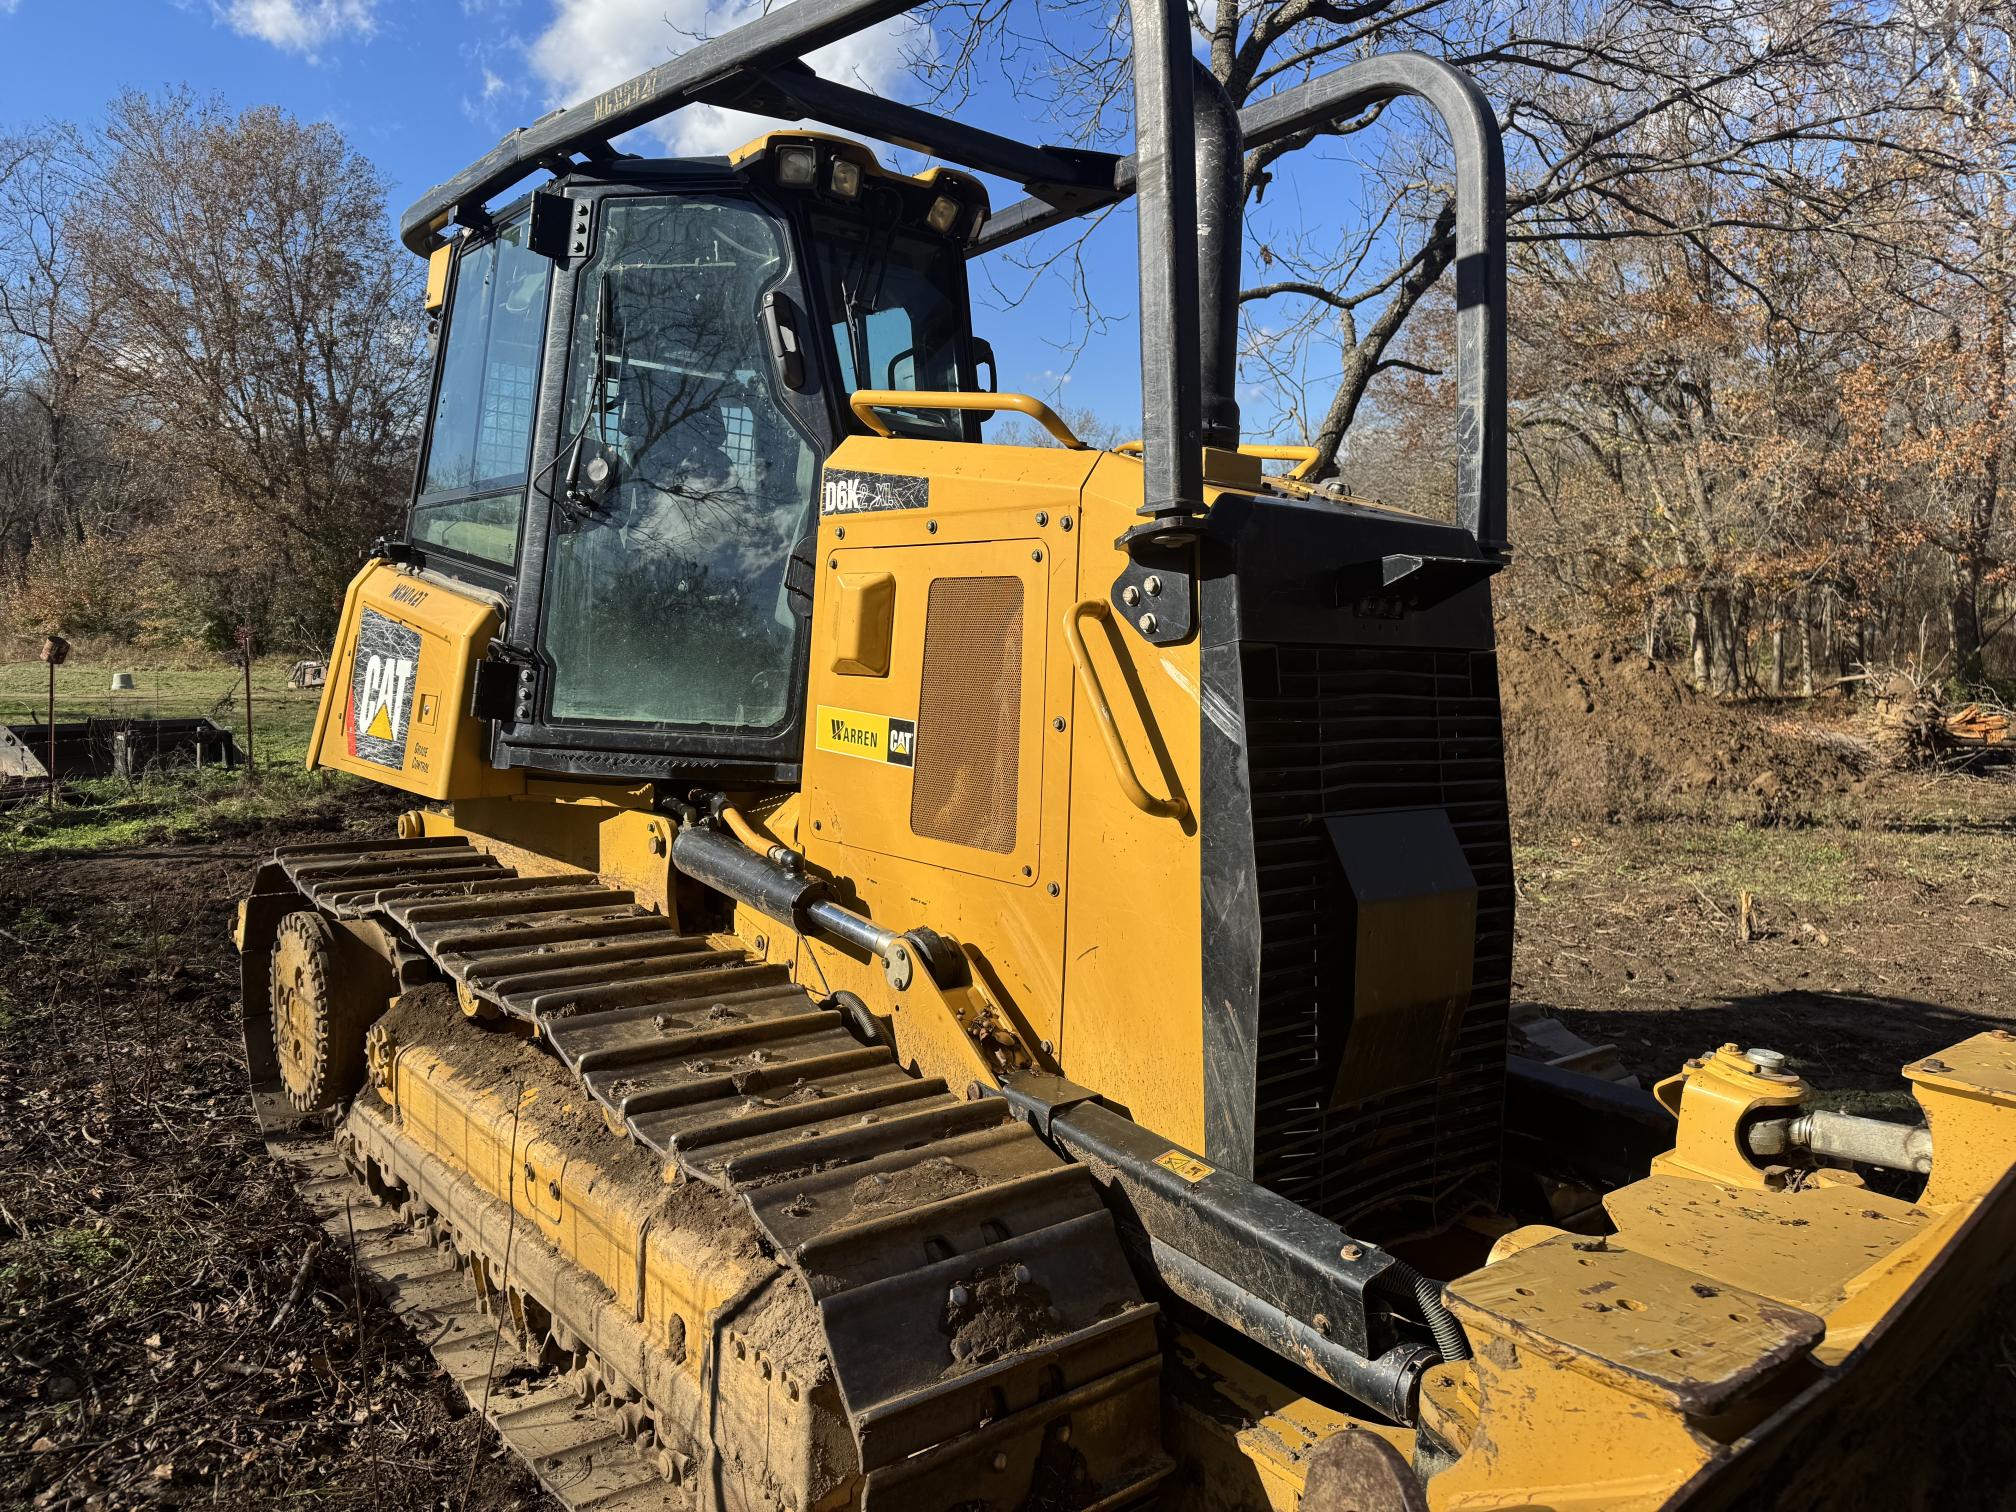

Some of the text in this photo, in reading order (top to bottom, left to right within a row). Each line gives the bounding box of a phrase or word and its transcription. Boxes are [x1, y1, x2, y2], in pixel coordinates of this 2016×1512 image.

[360, 654, 412, 741] CAT
[831, 719, 913, 755] WARREN CAT
